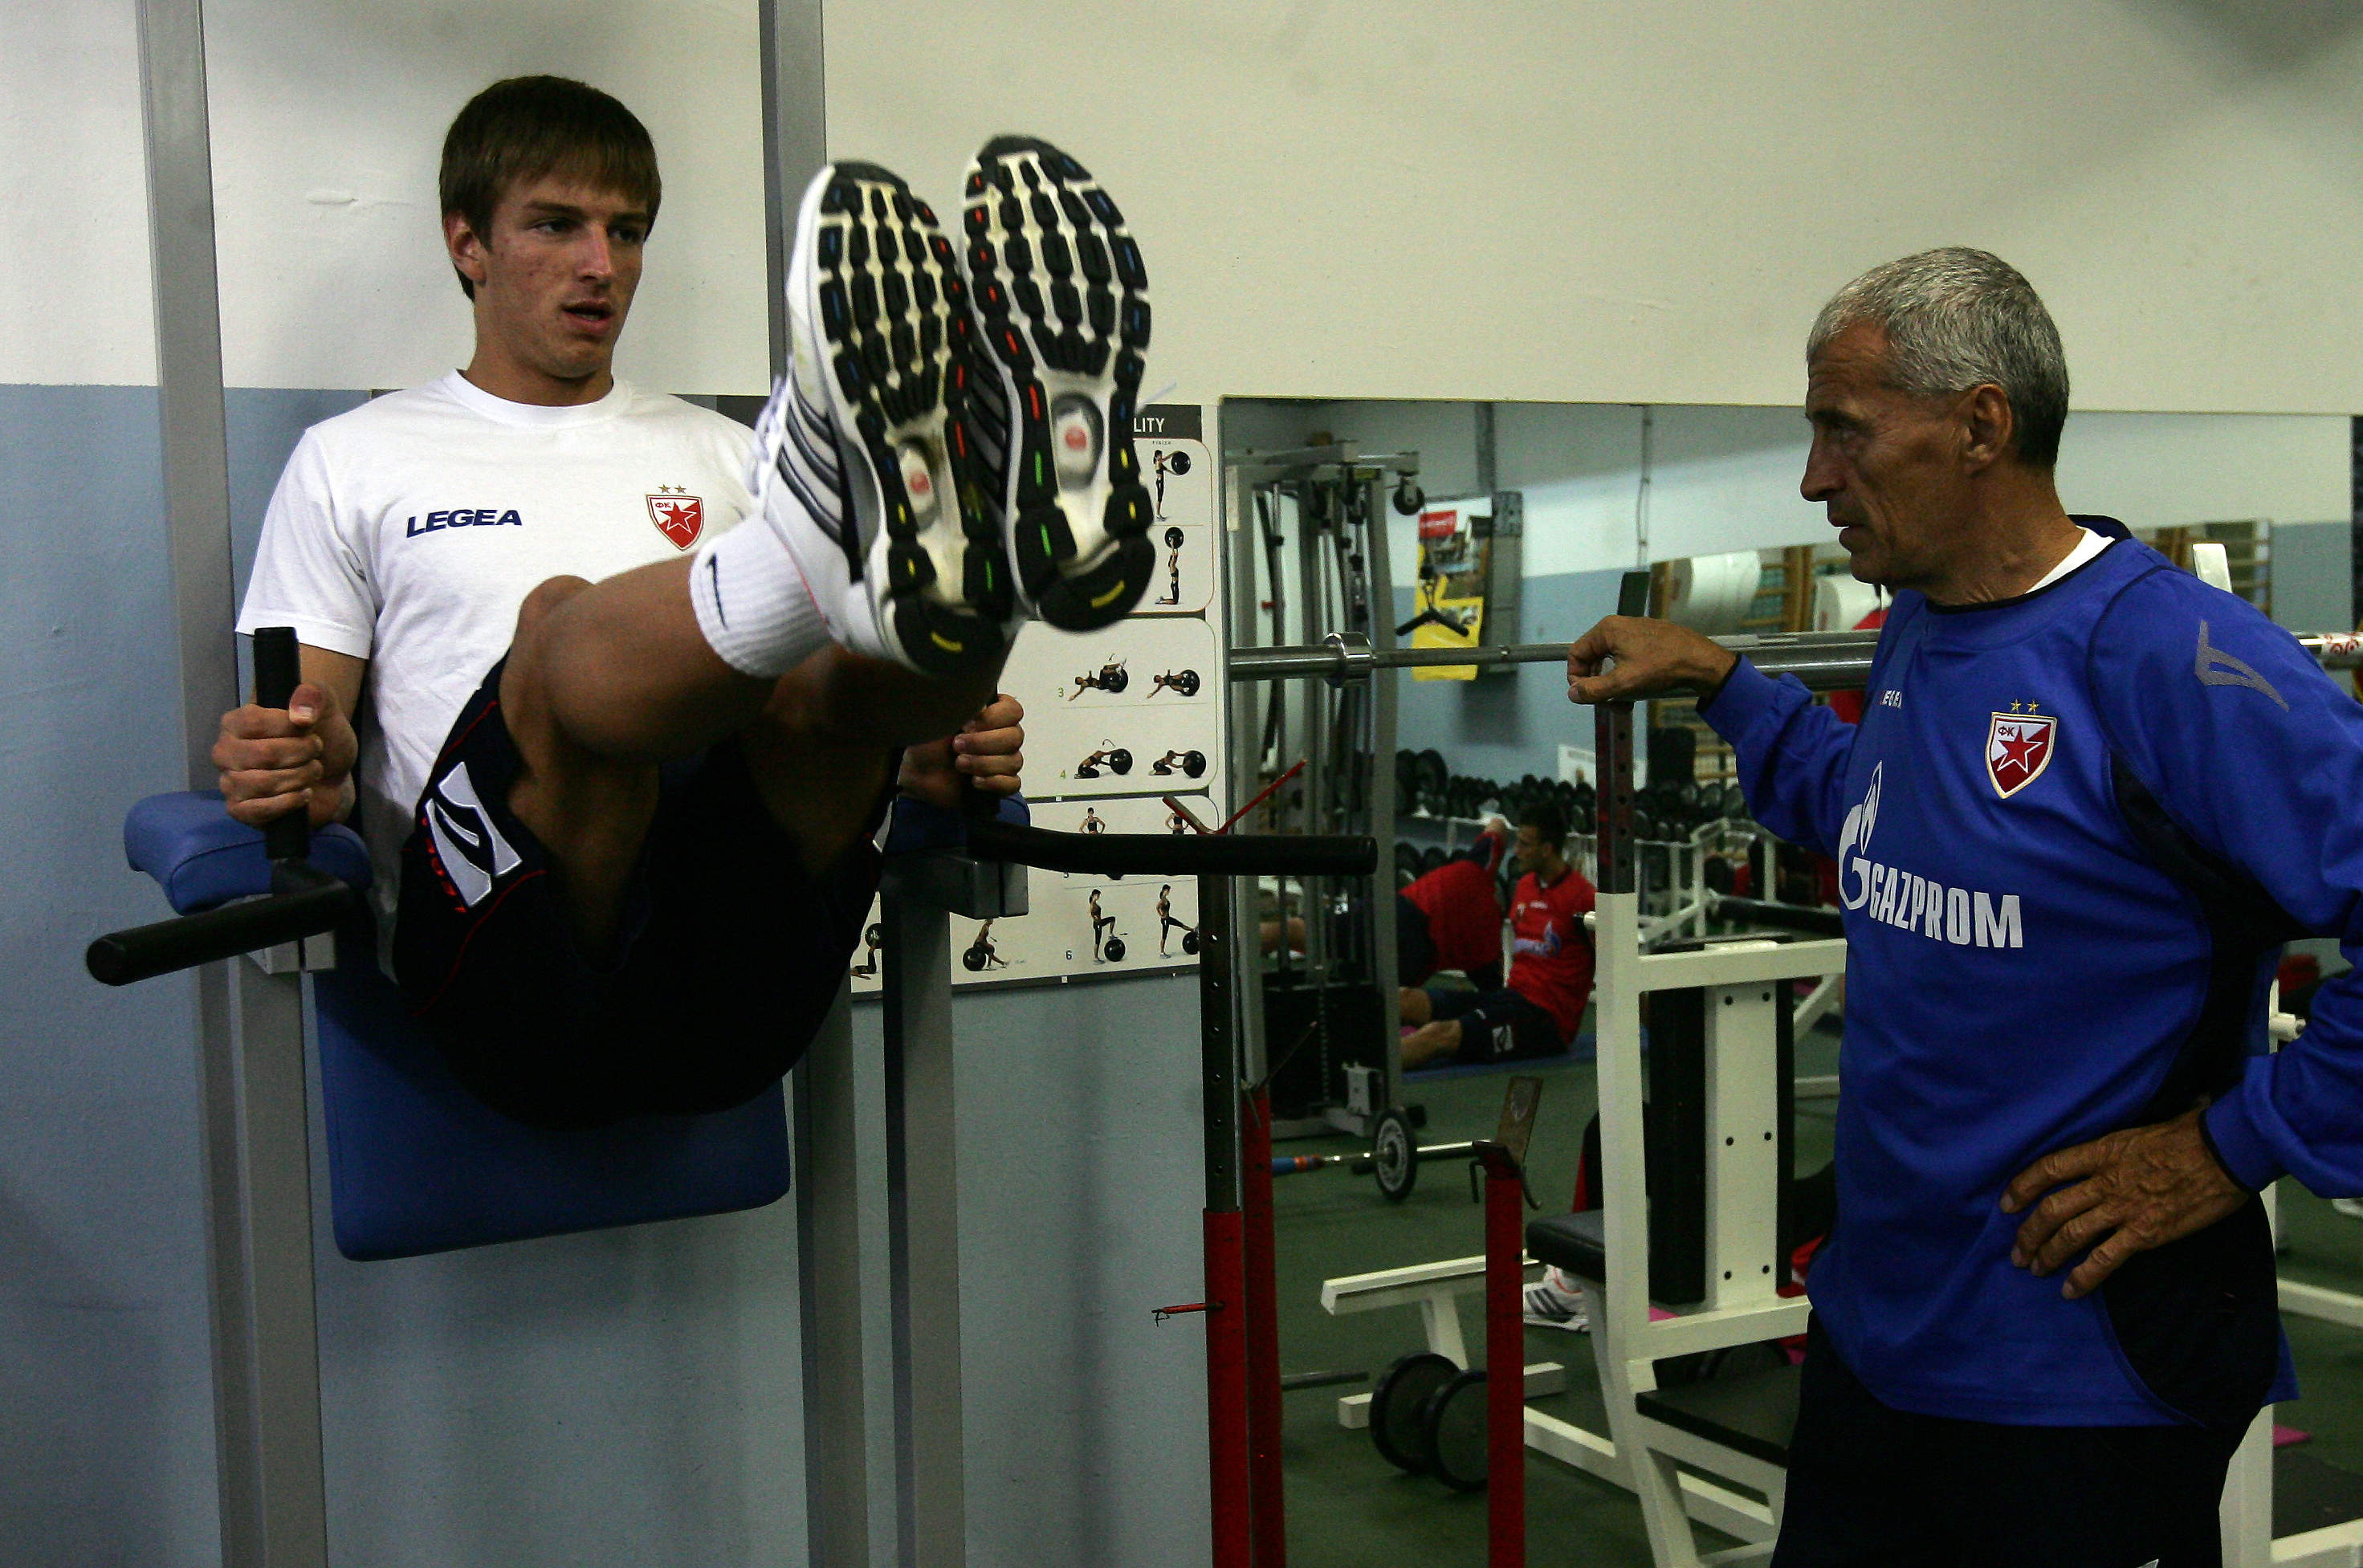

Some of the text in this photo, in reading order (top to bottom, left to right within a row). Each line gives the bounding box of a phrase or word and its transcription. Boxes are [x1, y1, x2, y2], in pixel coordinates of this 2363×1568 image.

[1133, 417, 1164, 433] LITY
[406, 509, 523, 538] LEGEA
[1058, 687, 1064, 697] 3
[1060, 770, 1066, 779] 4
[1869, 862, 2023, 948] GAZPROM
[1065, 950, 1073, 960] 6
